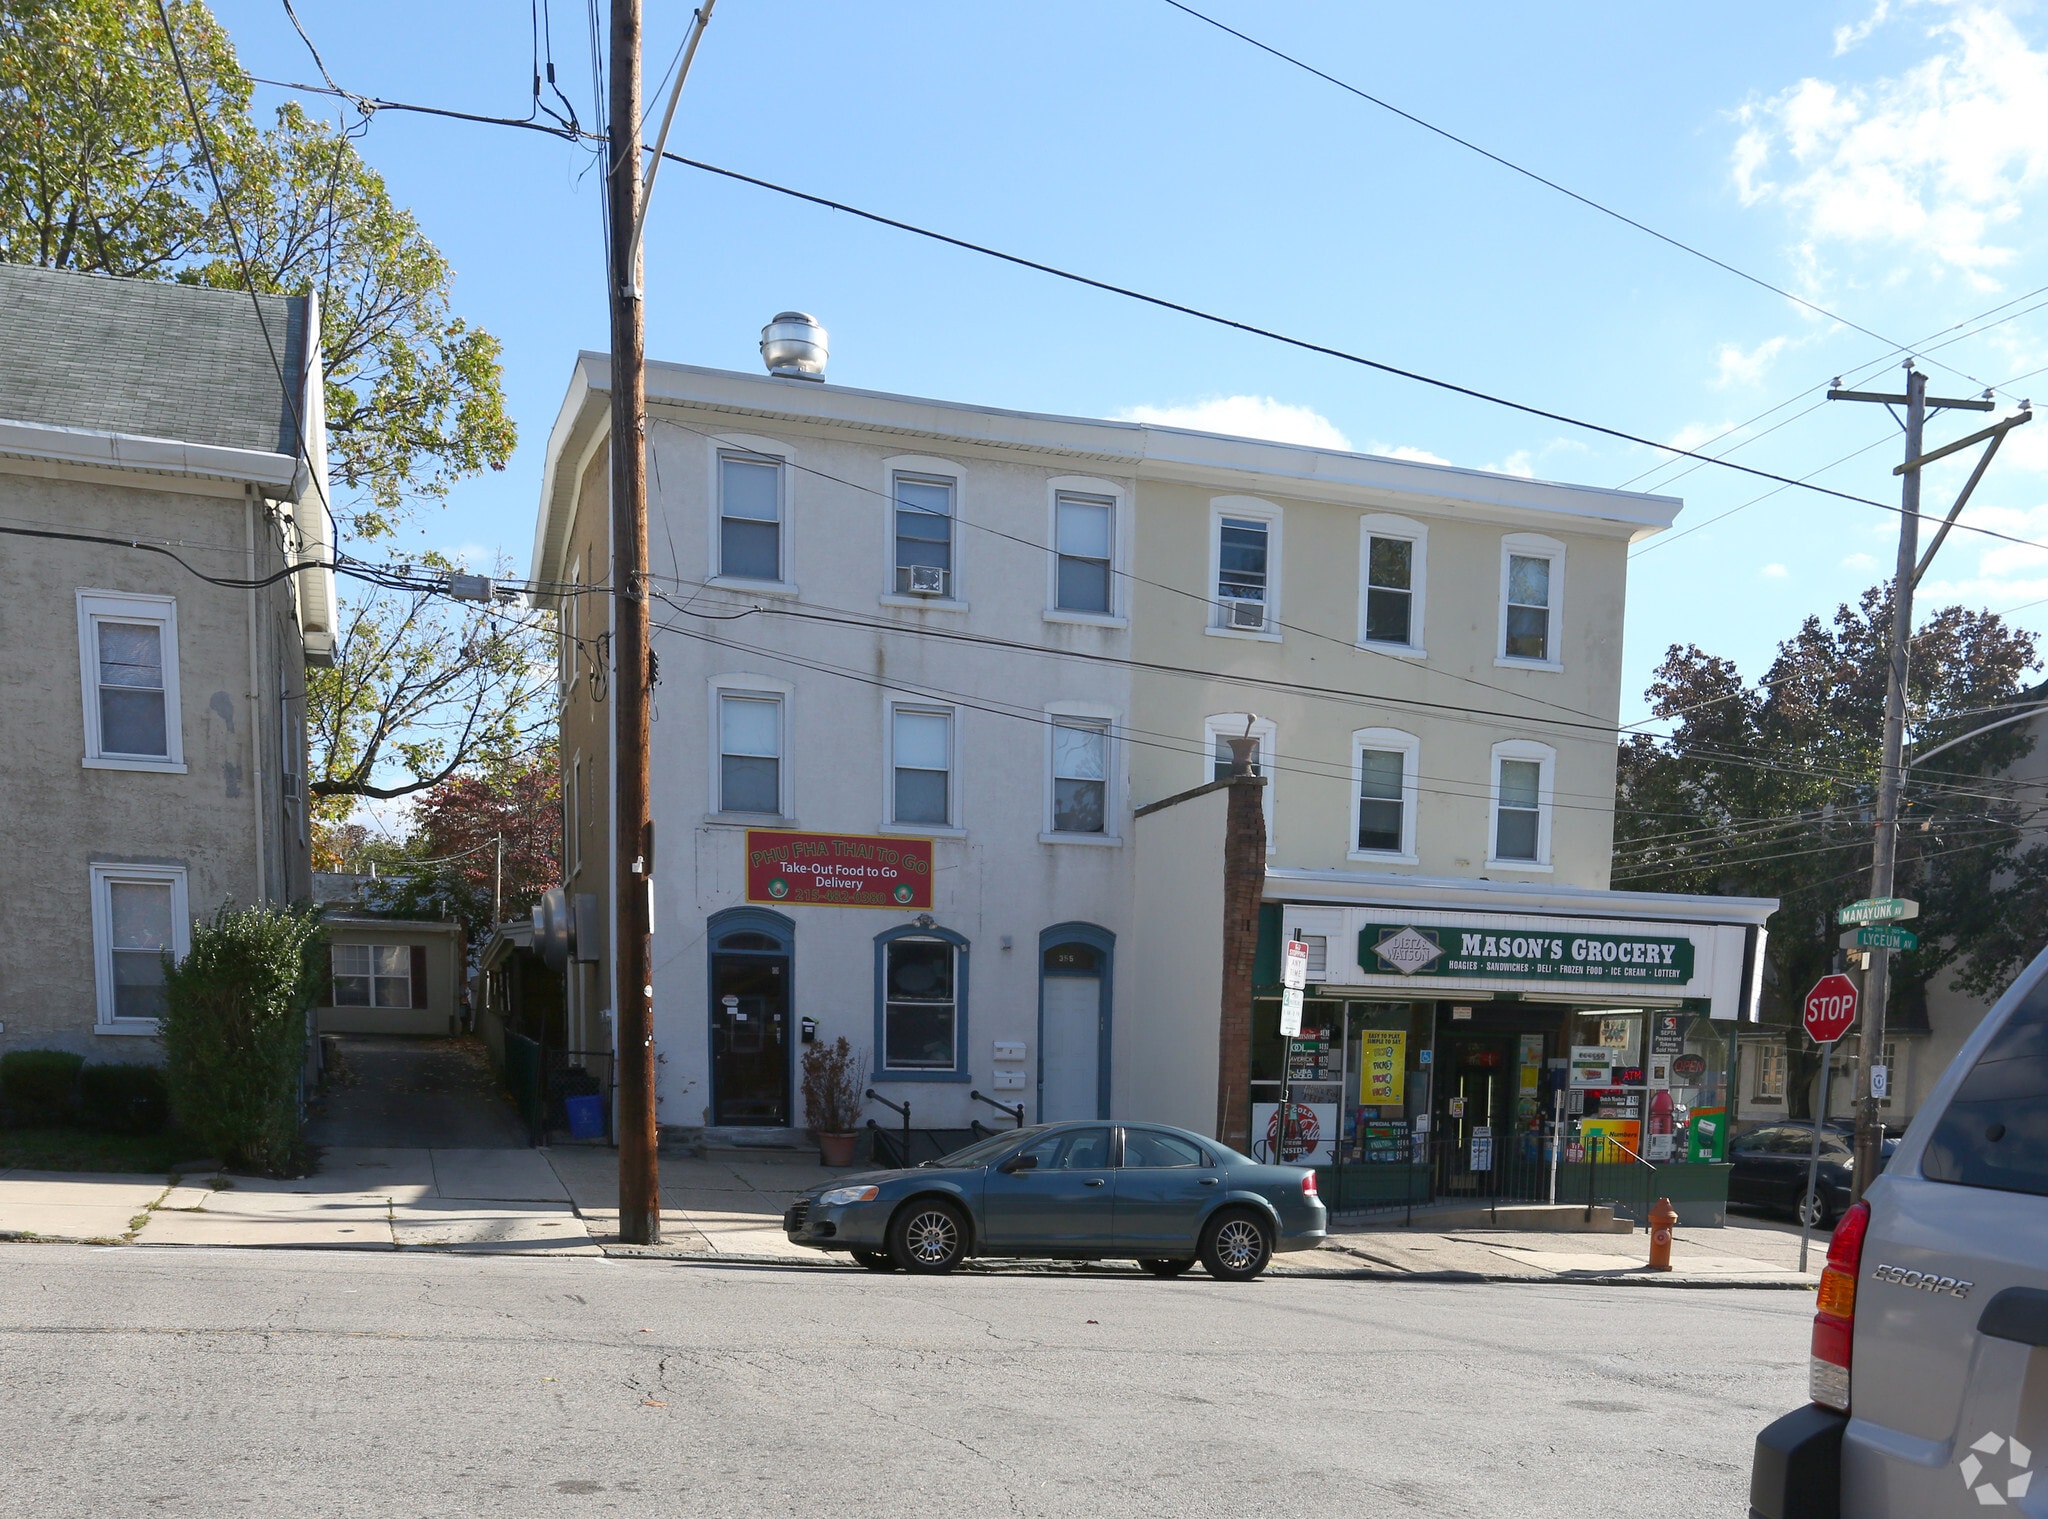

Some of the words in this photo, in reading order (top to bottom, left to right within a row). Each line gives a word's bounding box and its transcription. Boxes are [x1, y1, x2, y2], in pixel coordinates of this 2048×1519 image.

[751, 846, 788, 867] PHU
[792, 842, 829, 858] FHA
[832, 840, 874, 859] THAI
[878, 848, 899, 864] TO
[780, 862, 833, 875] Take-Out
[835, 864, 864, 876] Food
[867, 866, 879, 877] to
[881, 867, 898, 878] Go
[815, 876, 863, 891] Delivery
[795, 888, 886, 903] 215-482-0380
[1842, 904, 1892, 923] MANAYUNK
[1894, 906, 1902, 915] AV
[1393, 937, 1421, 950] DIETZ
[1461, 933, 1562, 960] MASON'S
[1571, 938, 1676, 965] GROCERY
[1863, 933, 1900, 948] LYCEUM
[1903, 940, 1912, 949] AV
[1387, 947, 1430, 961] WATSON
[1448, 960, 1478, 970] HOAGIES
[1486, 961, 1528, 972] SANDWICHES
[1537, 963, 1551, 973] DELI
[1560, 964, 1583, 974] FROZEN
[1586, 965, 1602, 975] FOOD
[1610, 966, 1621, 976] ICE
[1624, 967, 1646, 977] CREAM
[1654, 968, 1681, 978] LOTTERY
[1807, 995, 1853, 1022] STOP
[1674, 1059, 1704, 1073] OPEN
[1623, 1069, 1642, 1080] ATM
[1292, 1106, 1314, 1118] COLD
[1871, 1262, 1975, 1299] ESCAPE
